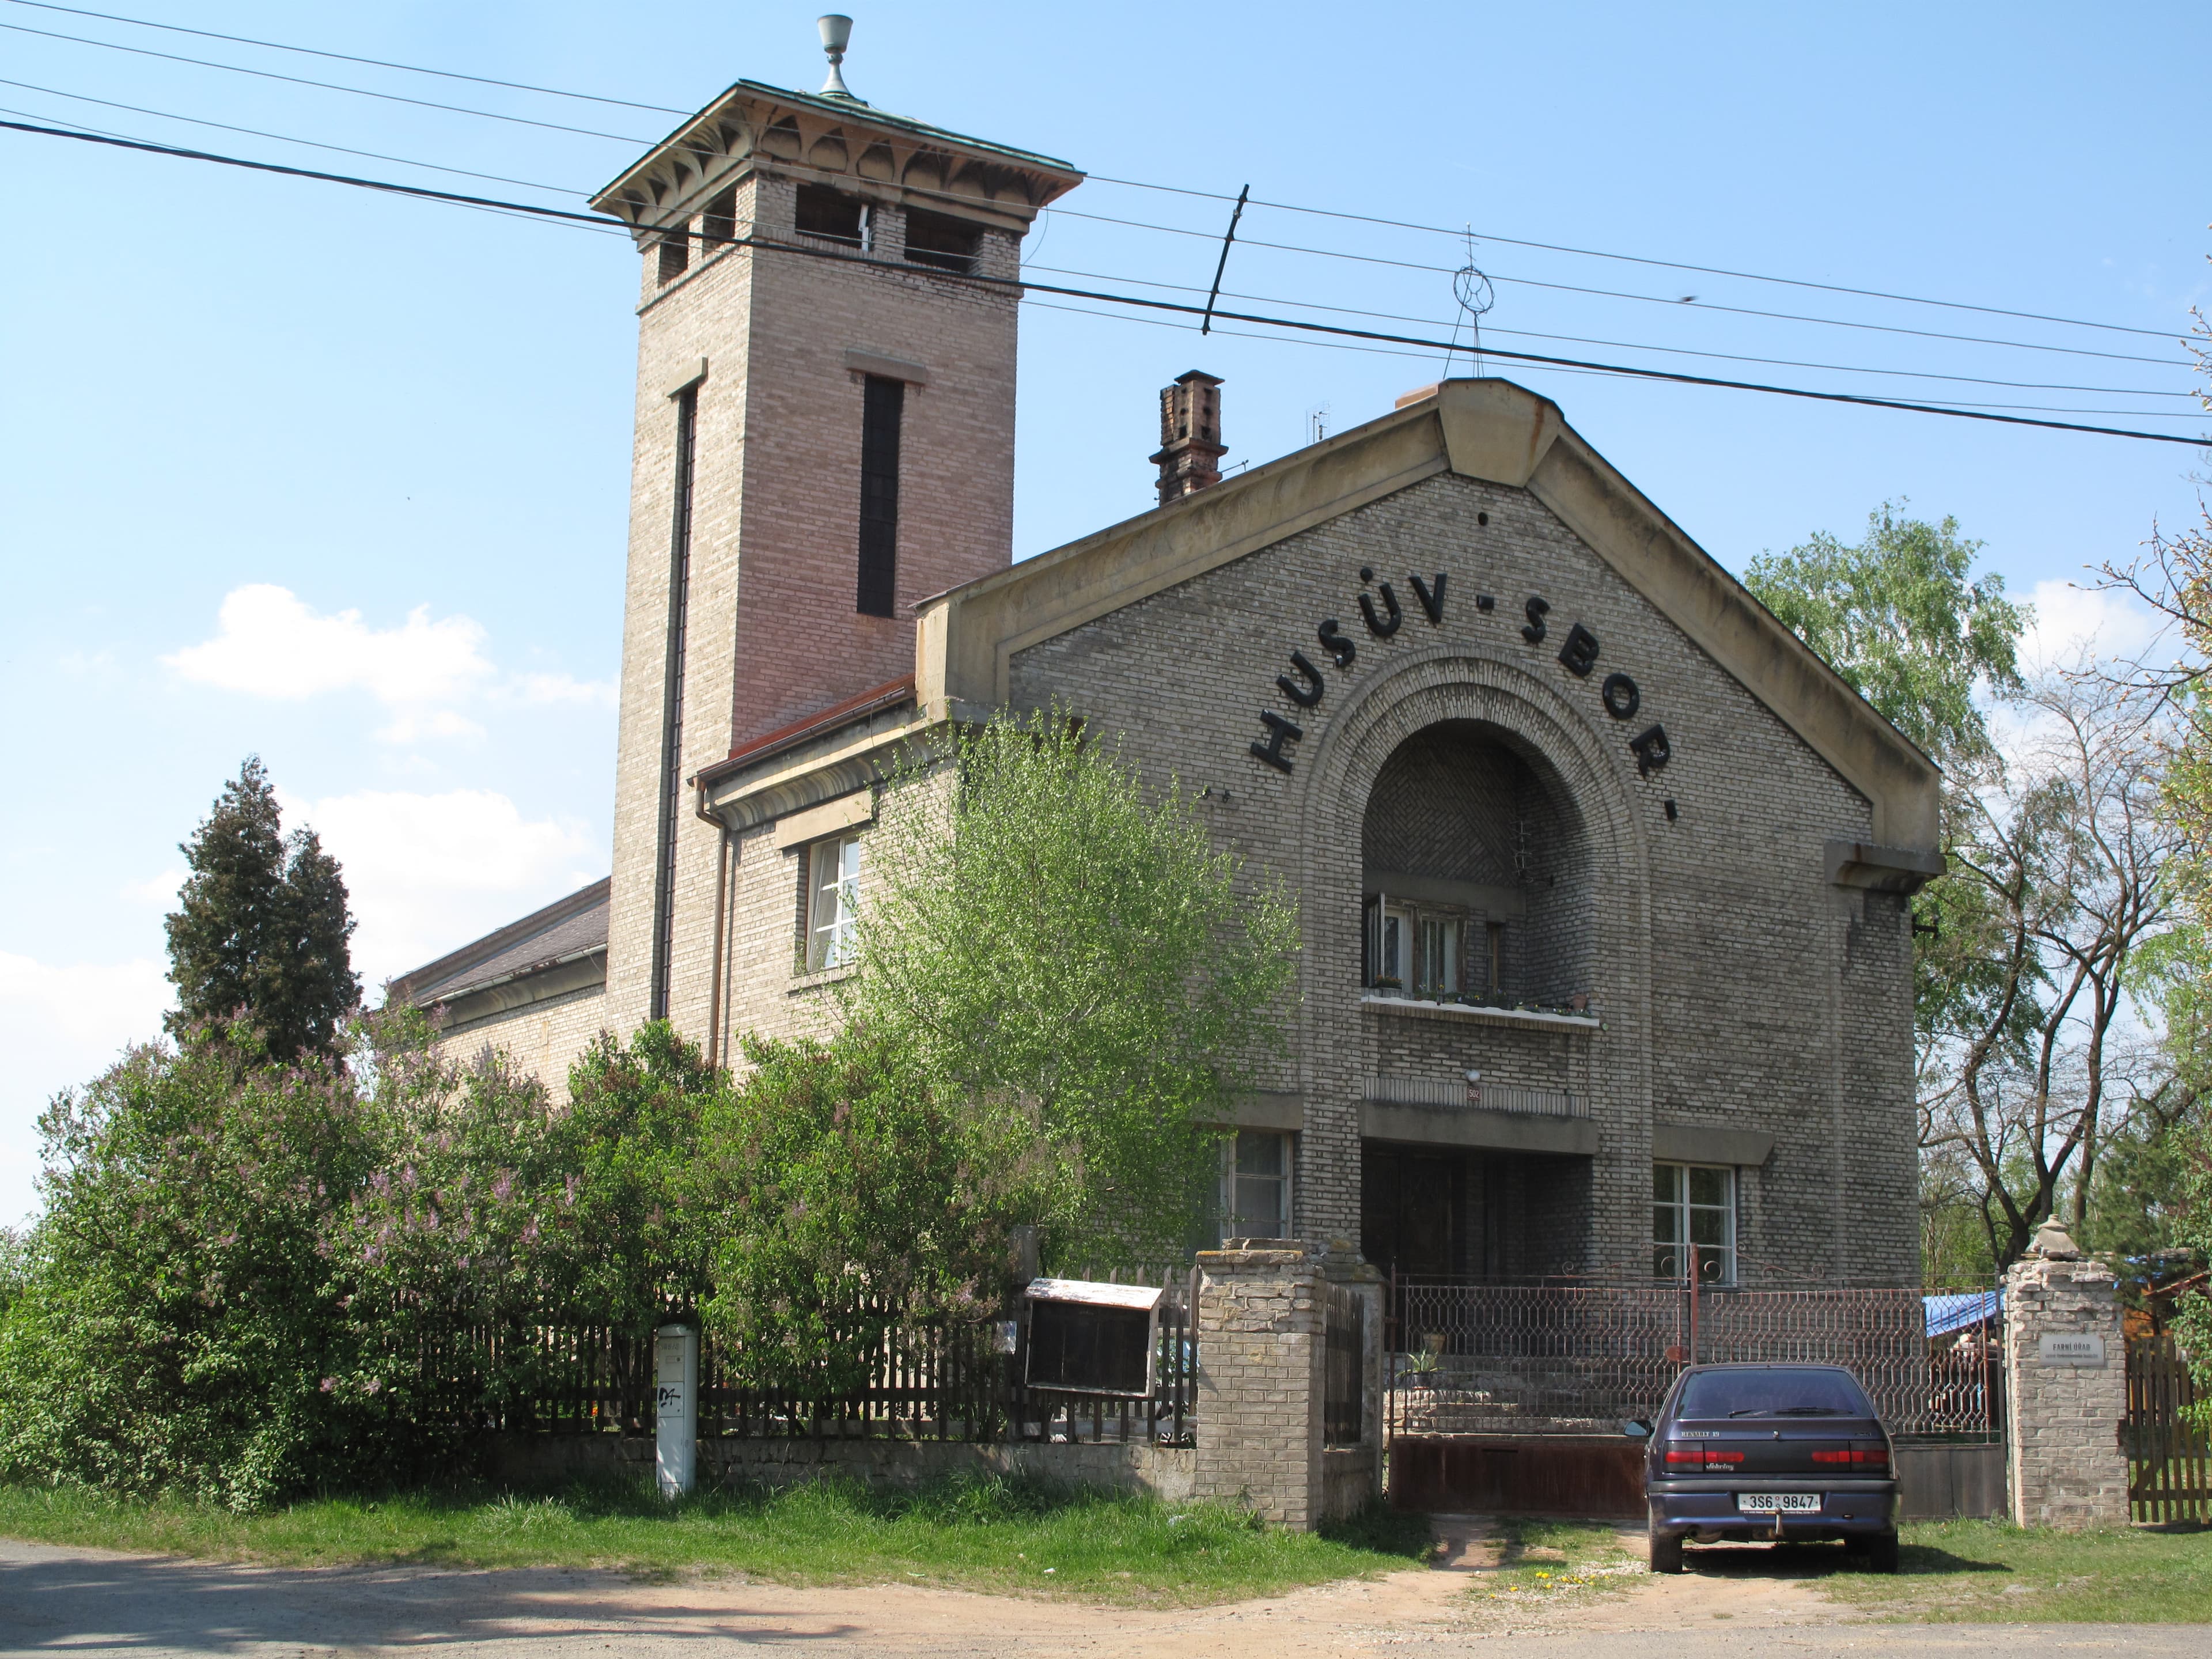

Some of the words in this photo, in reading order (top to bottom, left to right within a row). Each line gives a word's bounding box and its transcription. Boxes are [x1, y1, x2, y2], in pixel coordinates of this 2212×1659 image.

[1469, 1089, 1479, 1097] 502
[2052, 1342, 2071, 1351] FARNÍ
[1749, 1495, 1773, 1508] 3S6
[1783, 1495, 1814, 1509] 9847
